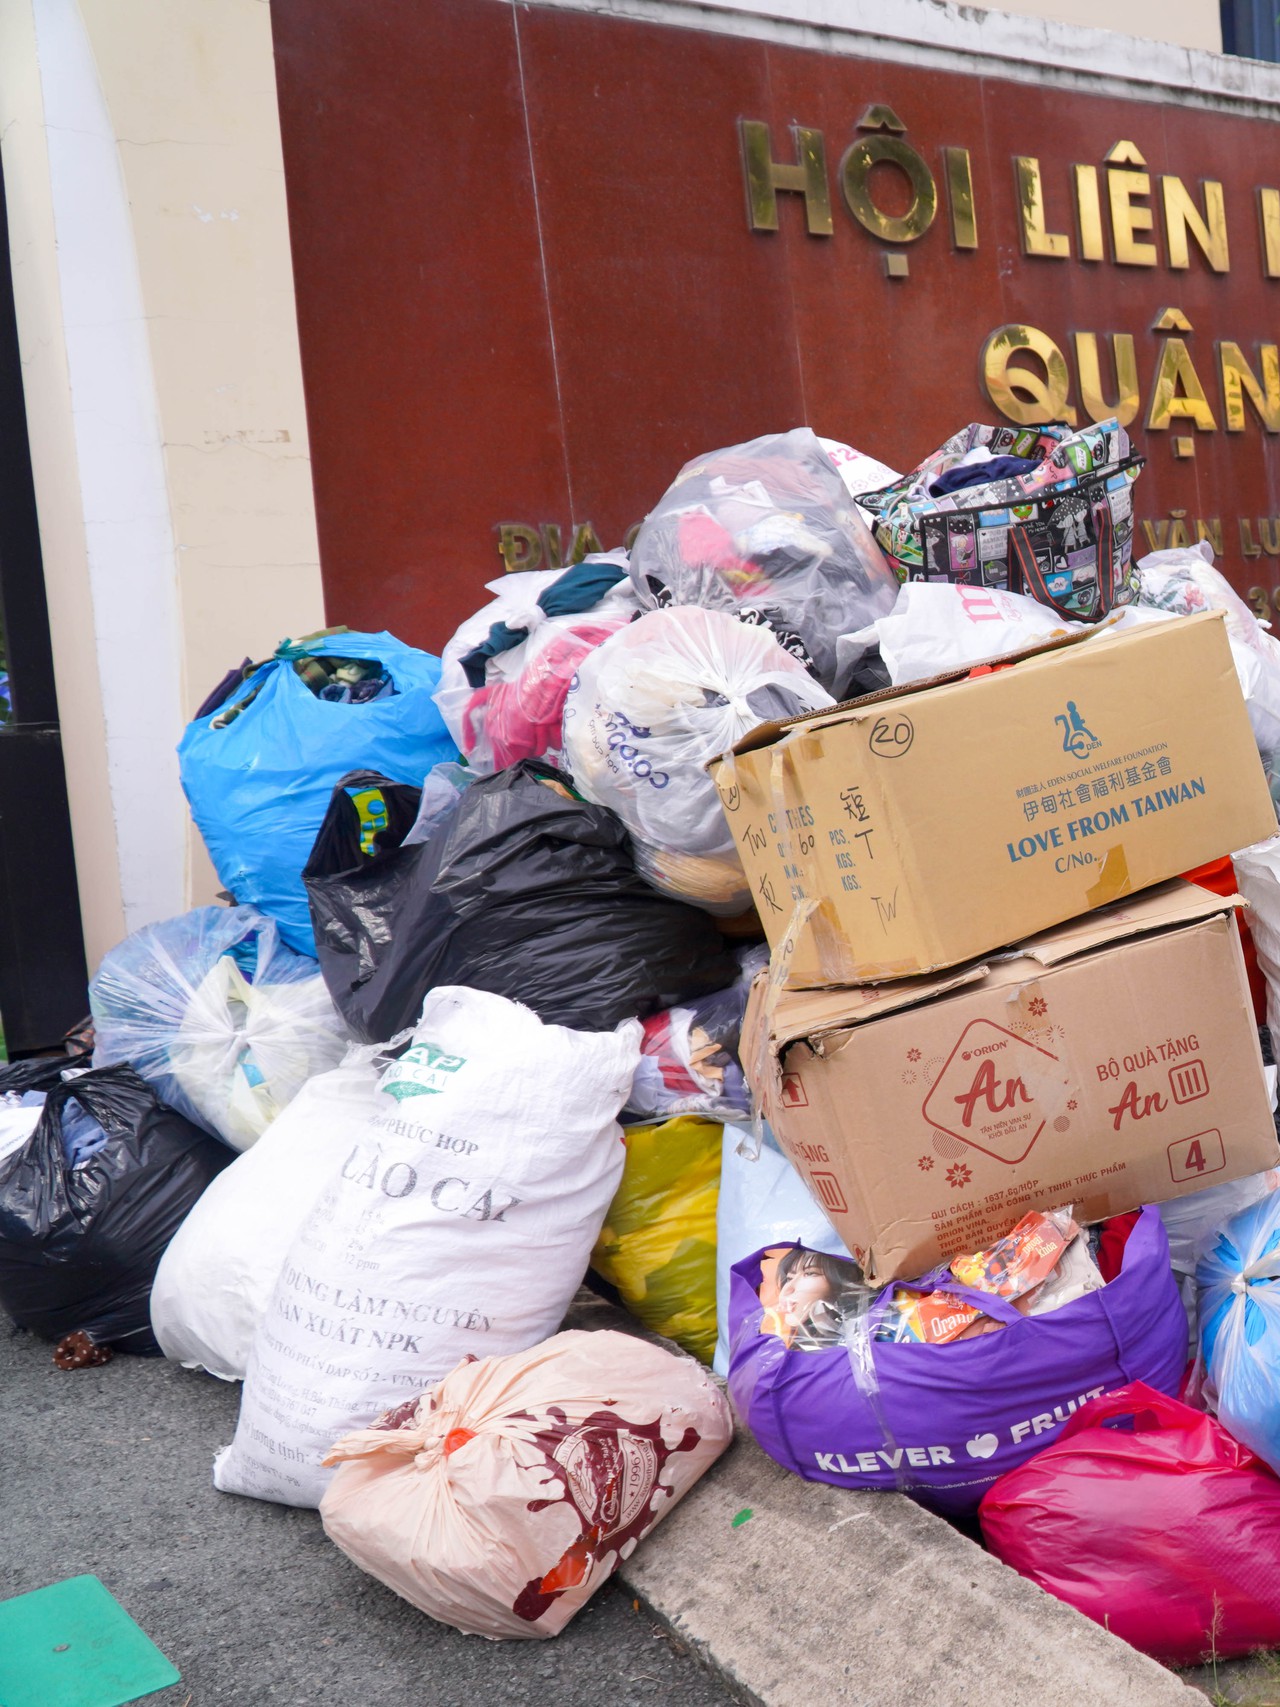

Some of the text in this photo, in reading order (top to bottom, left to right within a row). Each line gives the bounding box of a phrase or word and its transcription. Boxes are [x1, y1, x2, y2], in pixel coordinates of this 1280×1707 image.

[738, 104, 978, 277] HỘI
[1014, 139, 1230, 273] LIÊN
[1142, 510, 1224, 555] VĂN
[875, 716, 911, 744] 20
[1047, 741, 1168, 788] EDEN SOCIAL WELFARE FOUNDATION
[1022, 755, 1173, 822] 伊甸社會福利基金會
[1006, 776, 1207, 863] LOVE FROM TAIWAN
[829, 828, 850, 847] PCS.
[836, 852, 857, 870] KGS.
[1054, 850, 1099, 874] C/No.
[841, 874, 862, 892] KGS.
[973, 1041, 1006, 1057] ORION
[1096, 1034, 1200, 1083] BỘ QUÀ TẶNG
[954, 1059, 1034, 1128] An
[1108, 1081, 1168, 1131] An
[435, 1132, 480, 1158] HỢP
[1184, 1139, 1207, 1173] 4
[341, 1142, 418, 1199] LÀO
[984, 1202, 1005, 1214] CỦA
[1006, 1192, 1031, 1208] CÔNG
[1034, 1188, 1045, 1199] TY
[1048, 1180, 1073, 1194] TNHH
[1075, 1172, 1099, 1187] THỰC
[1100, 1161, 1127, 1177] PHẨM
[931, 1207, 947, 1221] QUI
[949, 1199, 975, 1214] CÁCH
[936, 1218, 990, 1242] ORION VINA.
[938, 1236, 963, 1250] THEO
[941, 1242, 972, 1257] ORION.
[974, 1235, 993, 1248] HÀN
[355, 1257, 381, 1271] ppm
[335, 1286, 388, 1319] LÀM
[398, 1299, 497, 1334] NGUYÊN
[304, 1310, 364, 1347] XUẤT
[367, 1328, 424, 1354] NPK
[628, 1456, 643, 1488] 1996
[814, 1445, 955, 1474] KLEVER
